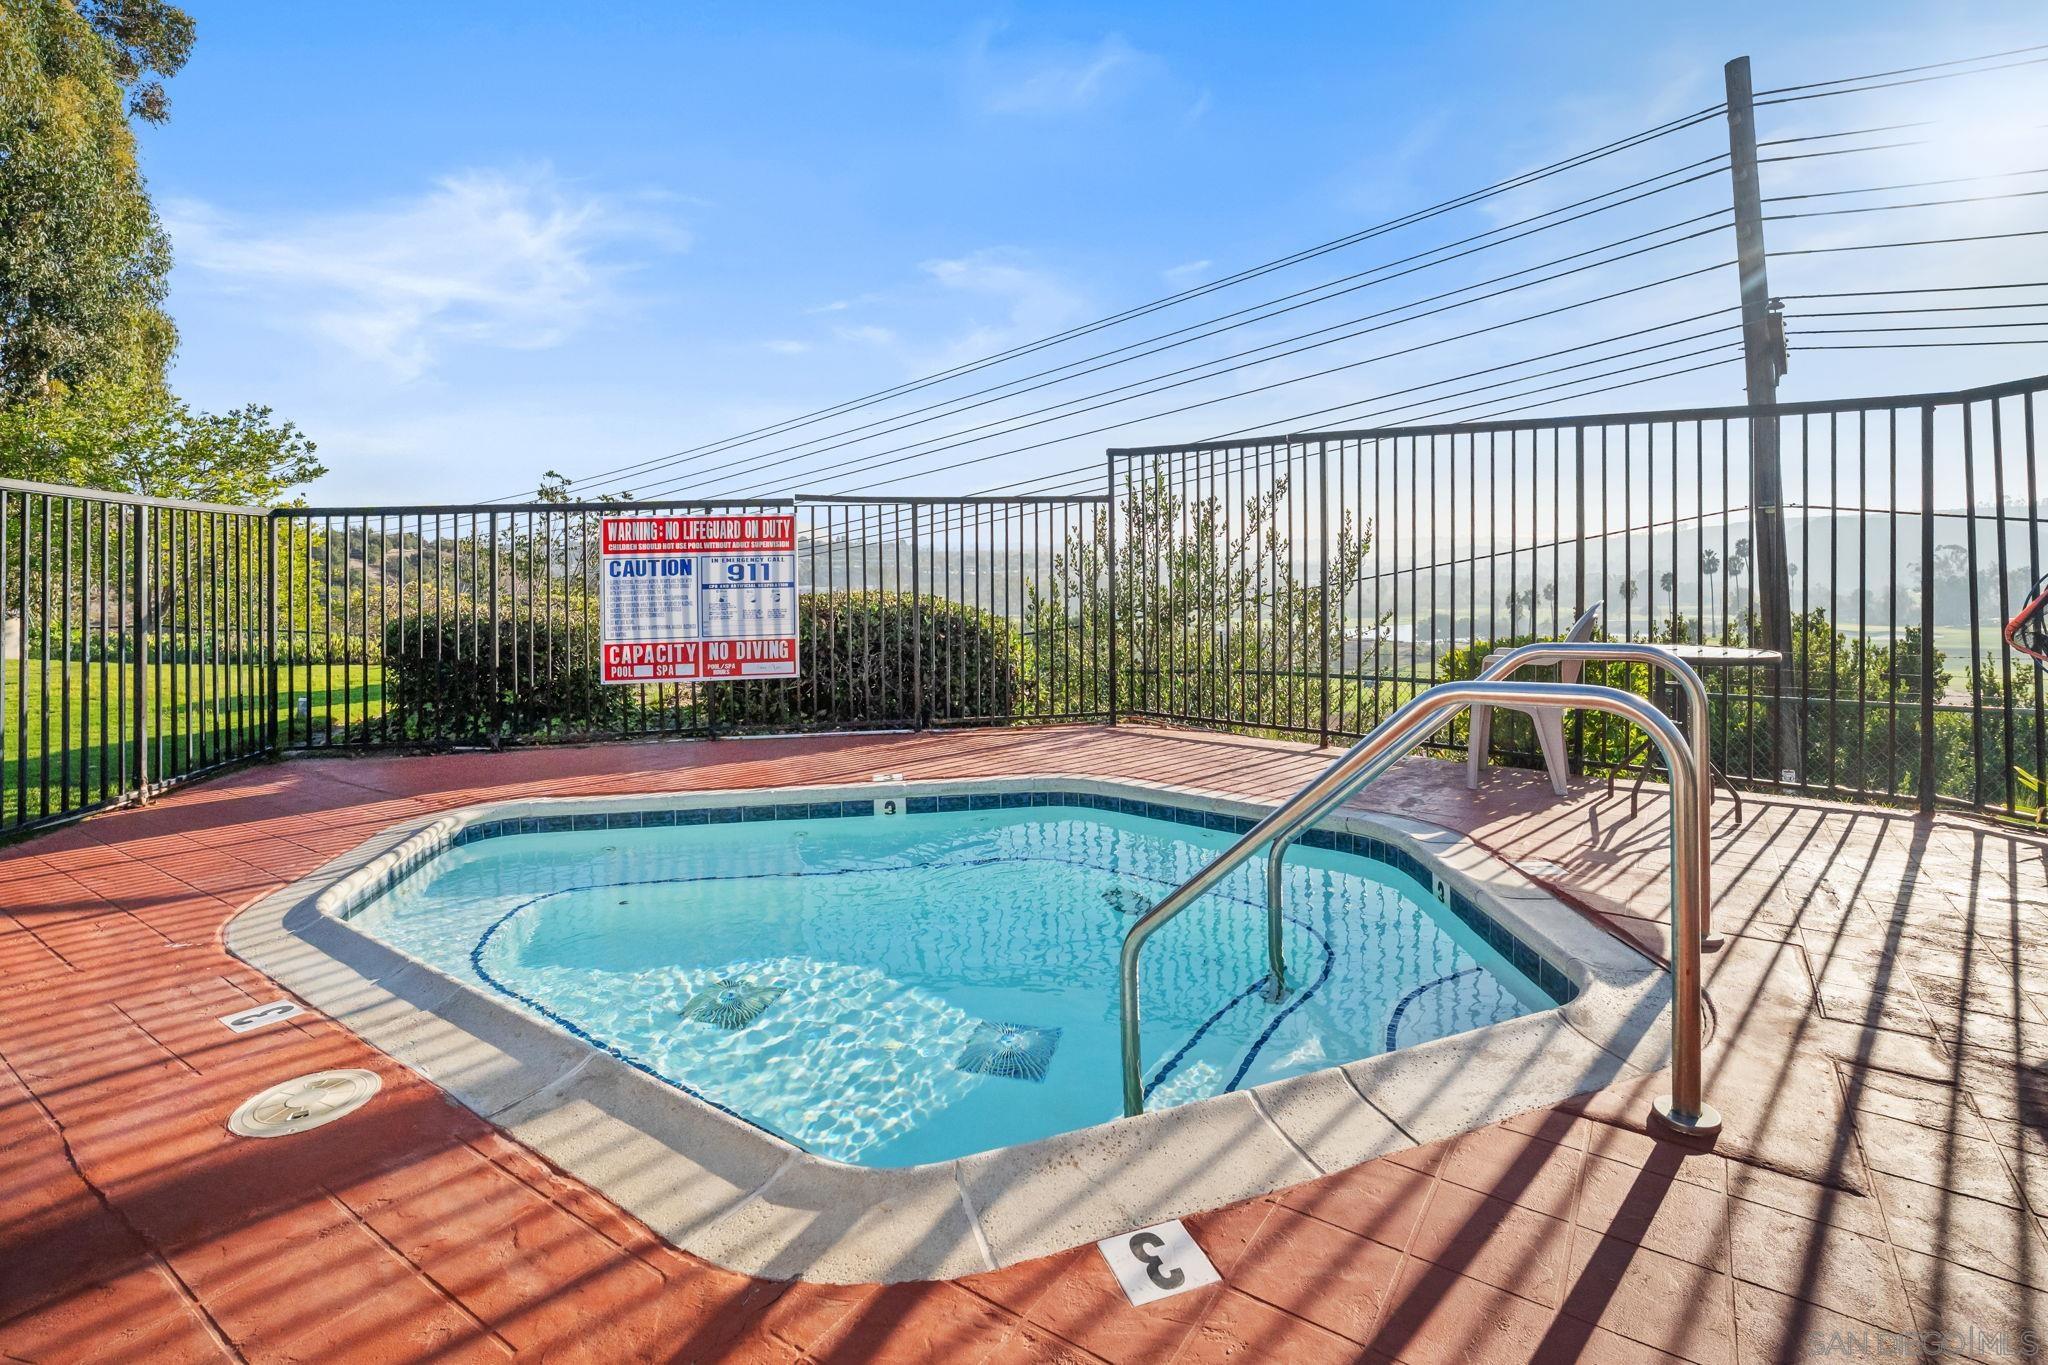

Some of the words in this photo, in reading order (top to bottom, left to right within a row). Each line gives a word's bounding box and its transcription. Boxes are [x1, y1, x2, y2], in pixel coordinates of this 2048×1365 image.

[607, 521, 663, 541] WARNING:
[665, 521, 680, 540] NO
[683, 520, 741, 540] LIFEGUARD
[744, 520, 759, 539] ON
[762, 519, 791, 539] DUTY
[608, 543, 637, 551] CHILDREN
[662, 542, 674, 550] NOT
[675, 542, 687, 550] USE
[703, 541, 731, 549] WITHOUT
[732, 541, 750, 549] ADULT
[750, 540, 790, 548] SUPERVISION
[609, 558, 692, 578] CAUTION
[727, 563, 770, 581] 911
[609, 643, 697, 664] CAPACITY
[708, 641, 729, 661] NO
[735, 640, 789, 660] DIVING
[611, 665, 633, 678] POOL
[656, 664, 674, 676] SPA
[884, 800, 896, 815] 3
[1437, 880, 1445, 904] 3
[230, 1005, 295, 1026] 3
[1129, 1232, 1185, 1290] 3
